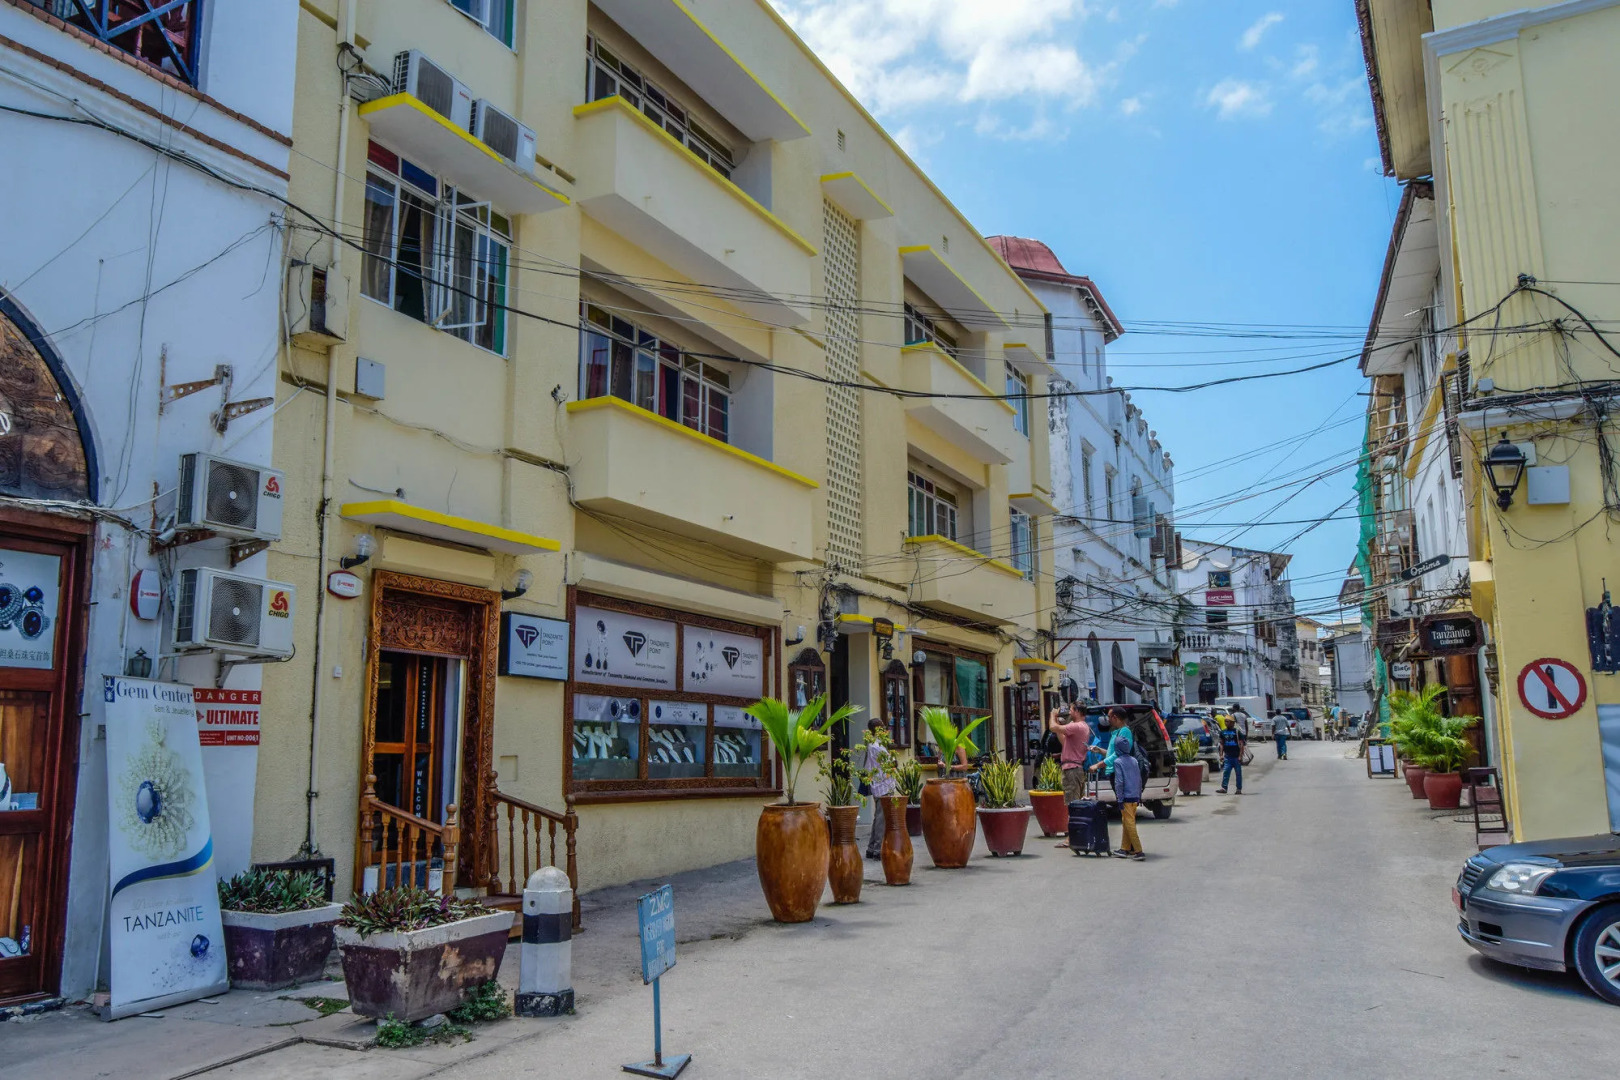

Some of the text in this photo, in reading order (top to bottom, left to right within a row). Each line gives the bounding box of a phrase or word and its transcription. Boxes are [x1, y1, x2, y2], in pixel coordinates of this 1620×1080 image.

[263, 491, 281, 500] CHIGO
[1410, 560, 1441, 577] Optima
[268, 609, 290, 619] CHIGO
[1431, 629, 1471, 640] Tanzanite
[116, 681, 193, 703] Gem Center
[195, 691, 259, 702] DANGER
[206, 710, 259, 725] ULTIMATE
[650, 892, 670, 917] ZMC
[123, 905, 204, 932] TANZANITE
